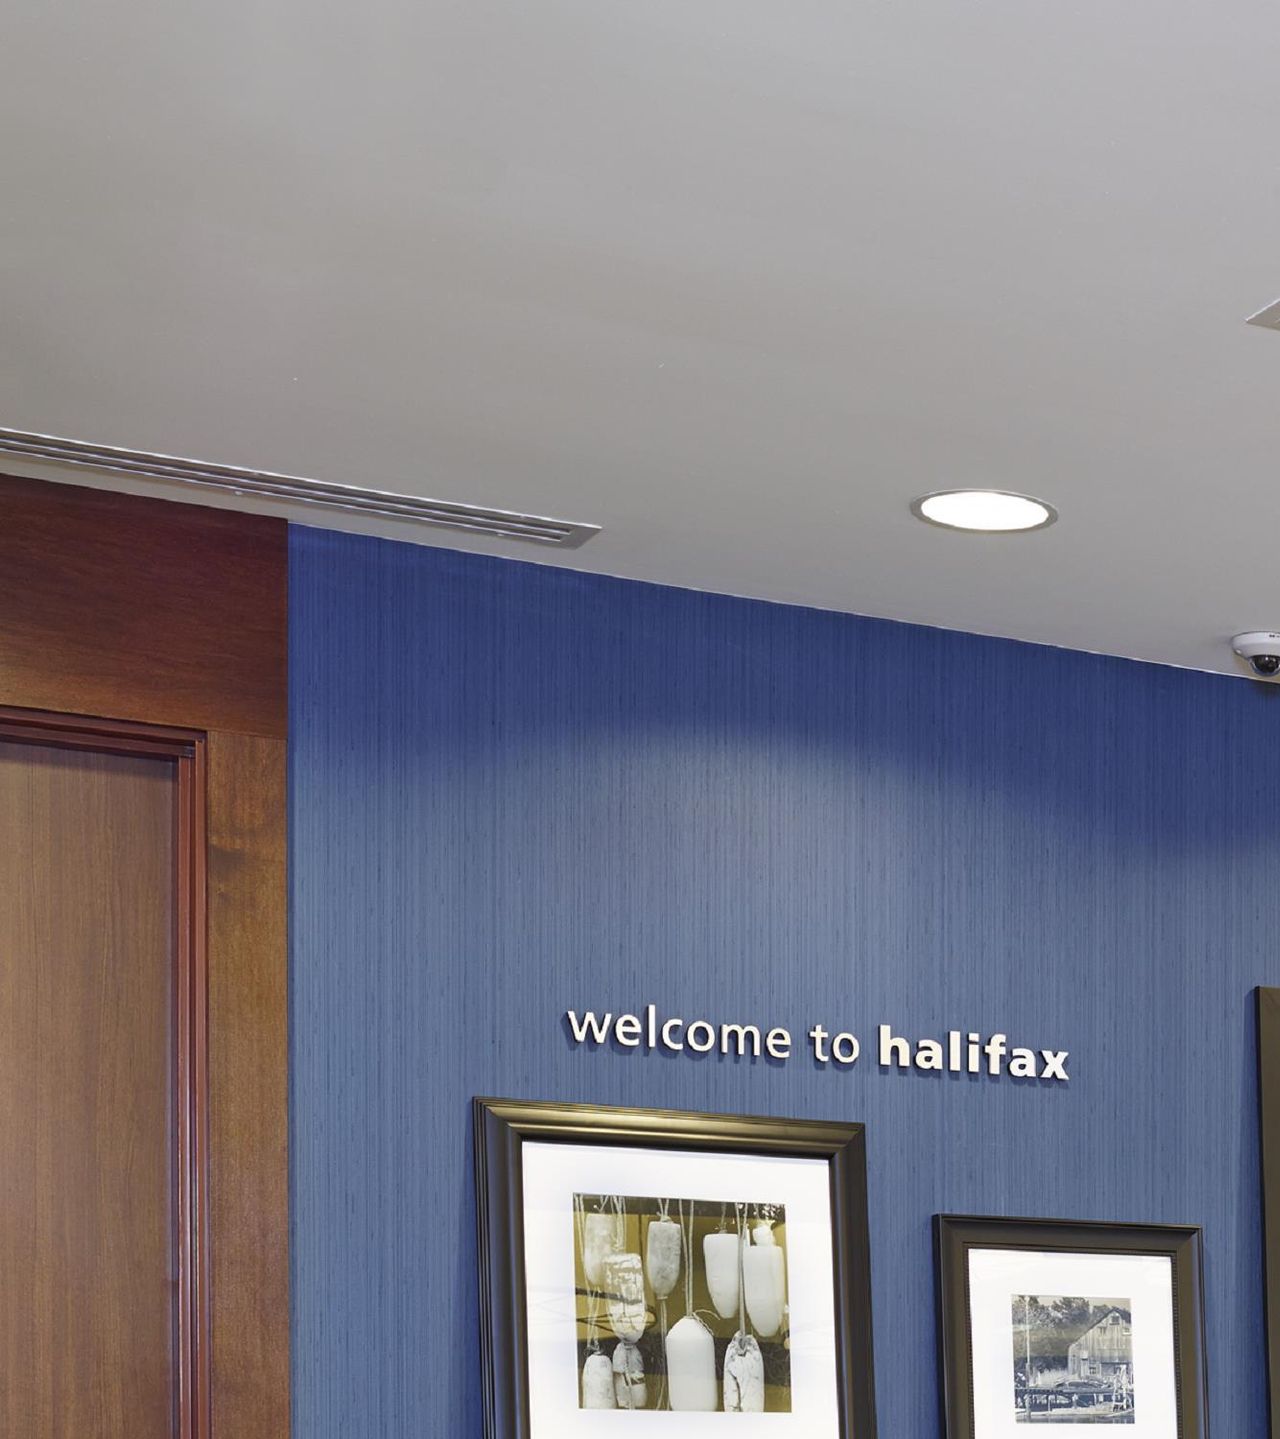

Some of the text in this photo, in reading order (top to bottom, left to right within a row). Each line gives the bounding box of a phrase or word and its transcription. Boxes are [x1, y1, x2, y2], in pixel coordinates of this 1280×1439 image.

[567, 1004, 1069, 1081] welcome to halifax
